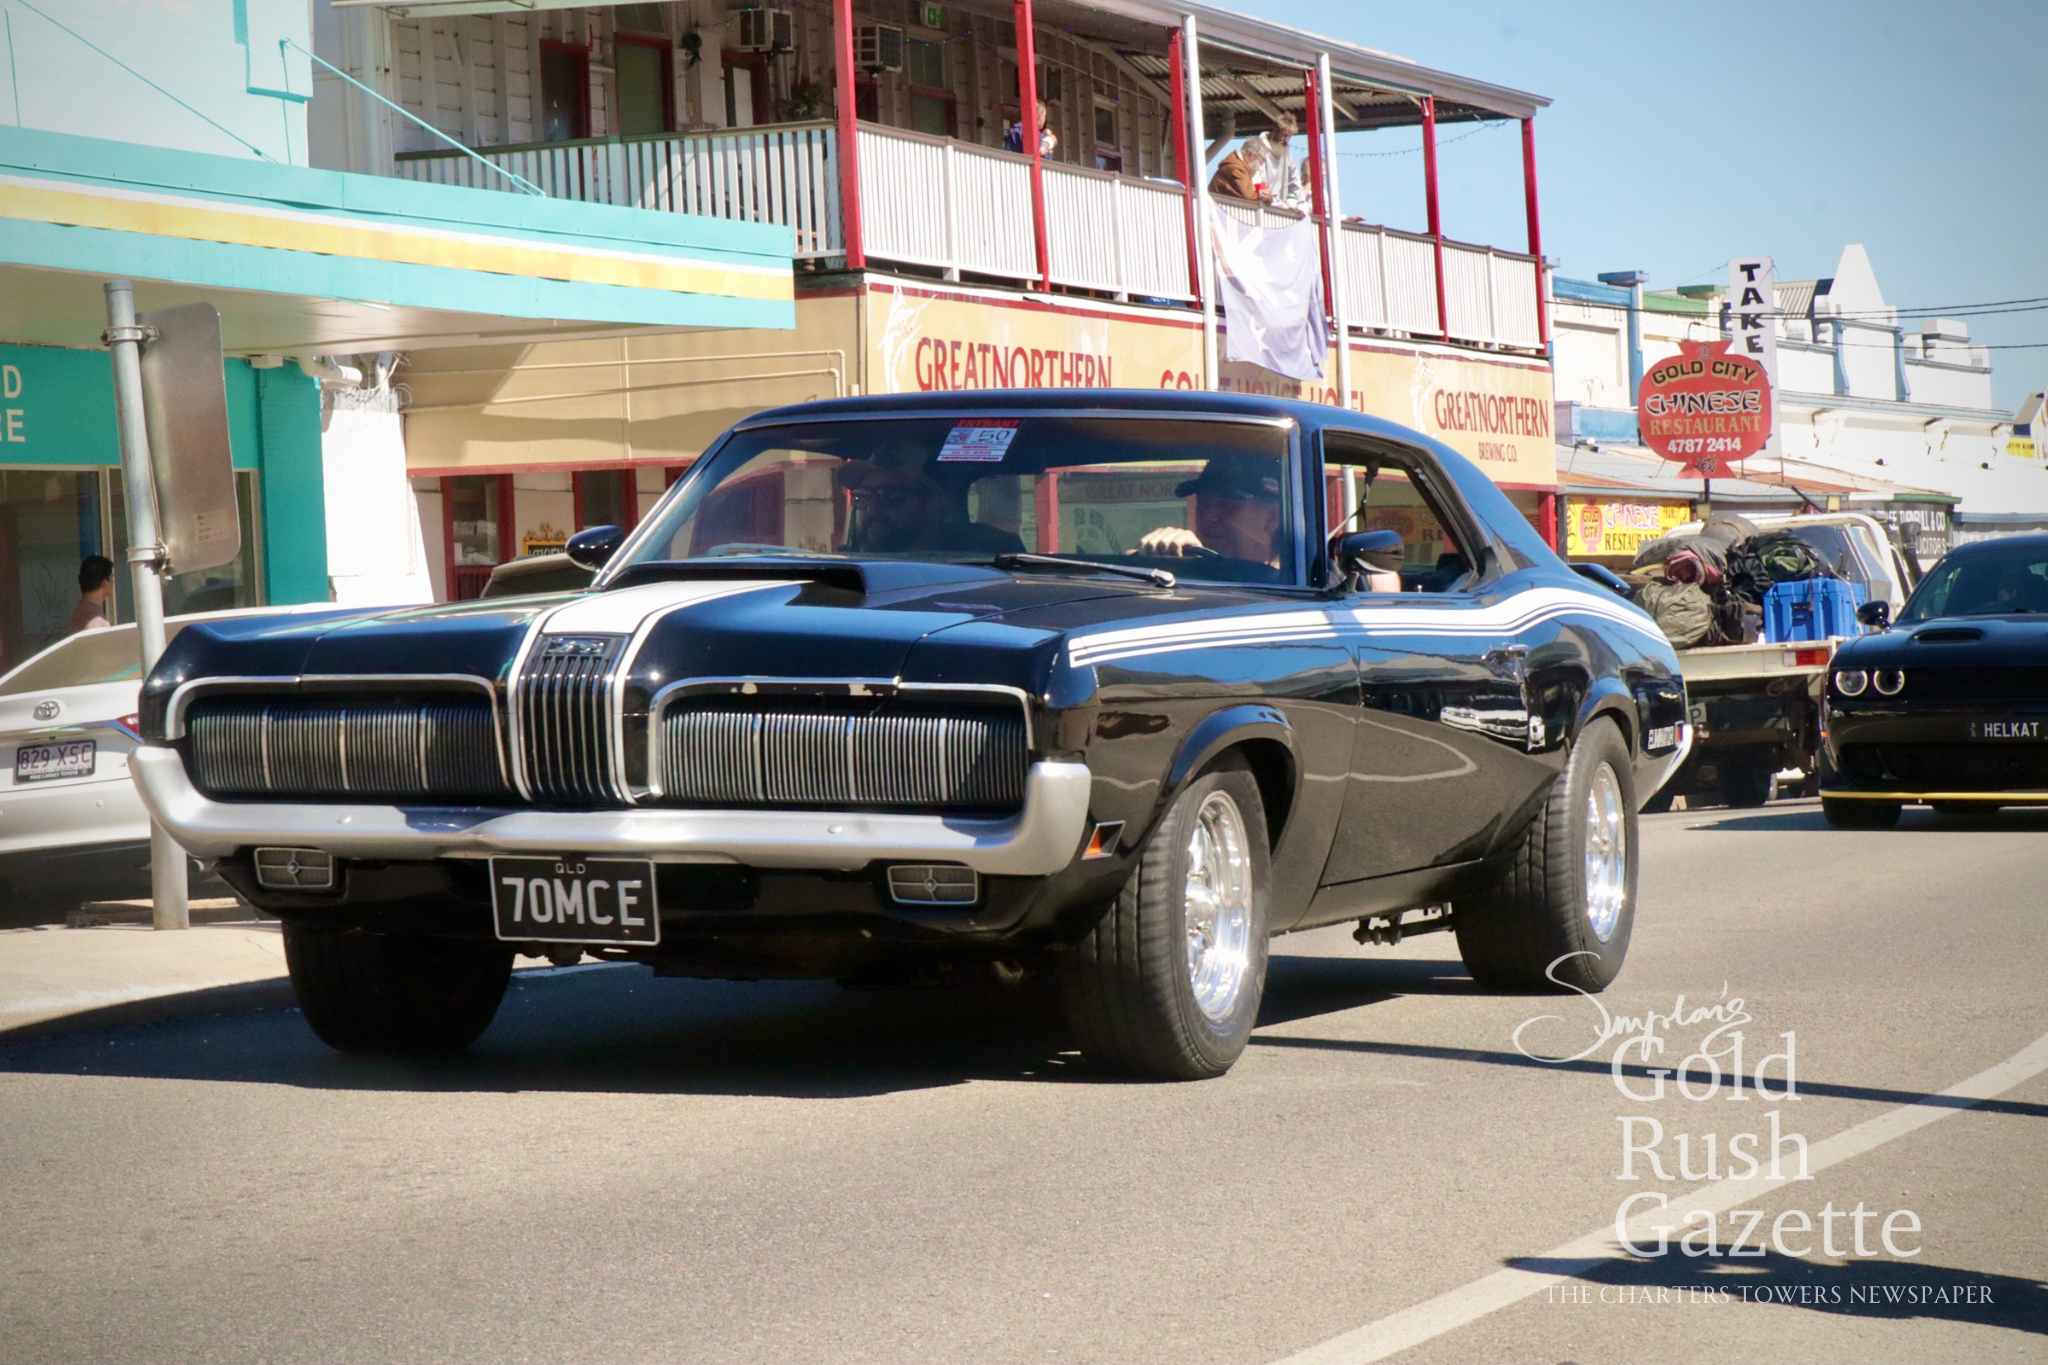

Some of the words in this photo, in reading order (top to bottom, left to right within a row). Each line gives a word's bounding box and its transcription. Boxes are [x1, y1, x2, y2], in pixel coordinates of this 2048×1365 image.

[1652, 360, 1705, 386] GOLD
[1712, 361, 1758, 386] CITY
[1645, 389, 1762, 416] CHINESE
[1650, 415, 1762, 436] RESTAURANT
[1478, 442, 1505, 461] BREWING
[1667, 438, 1703, 454] 4787
[1706, 437, 1742, 452] 2414
[1604, 502, 1660, 531] CHINESE
[1984, 722, 2039, 738] HELKAT
[555, 862, 586, 875] QLD
[502, 877, 645, 926] 70MCE
